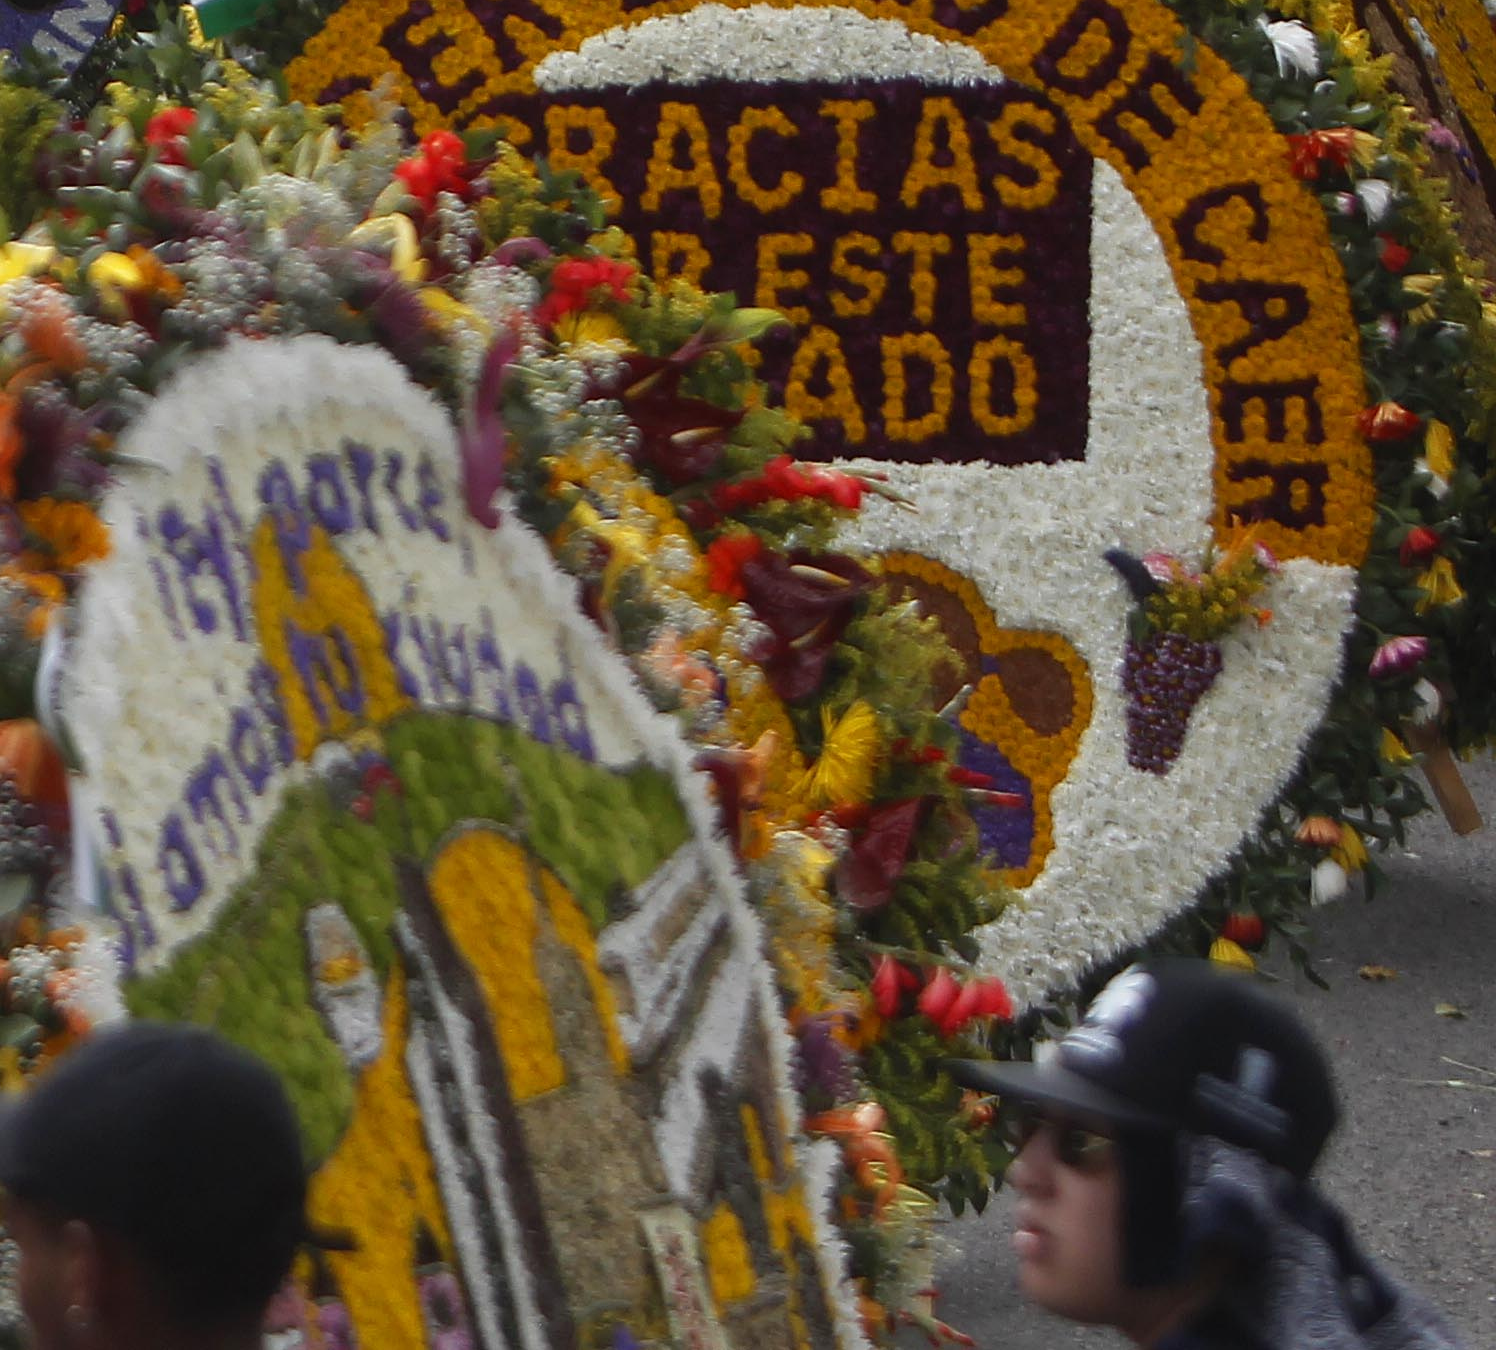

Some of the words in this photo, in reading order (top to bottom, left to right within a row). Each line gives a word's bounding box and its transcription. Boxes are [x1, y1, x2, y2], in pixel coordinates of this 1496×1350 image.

[756, 231, 1029, 325] ESTE
[753, 325, 1039, 444] ADO
[1173, 176, 1331, 532] CAER
